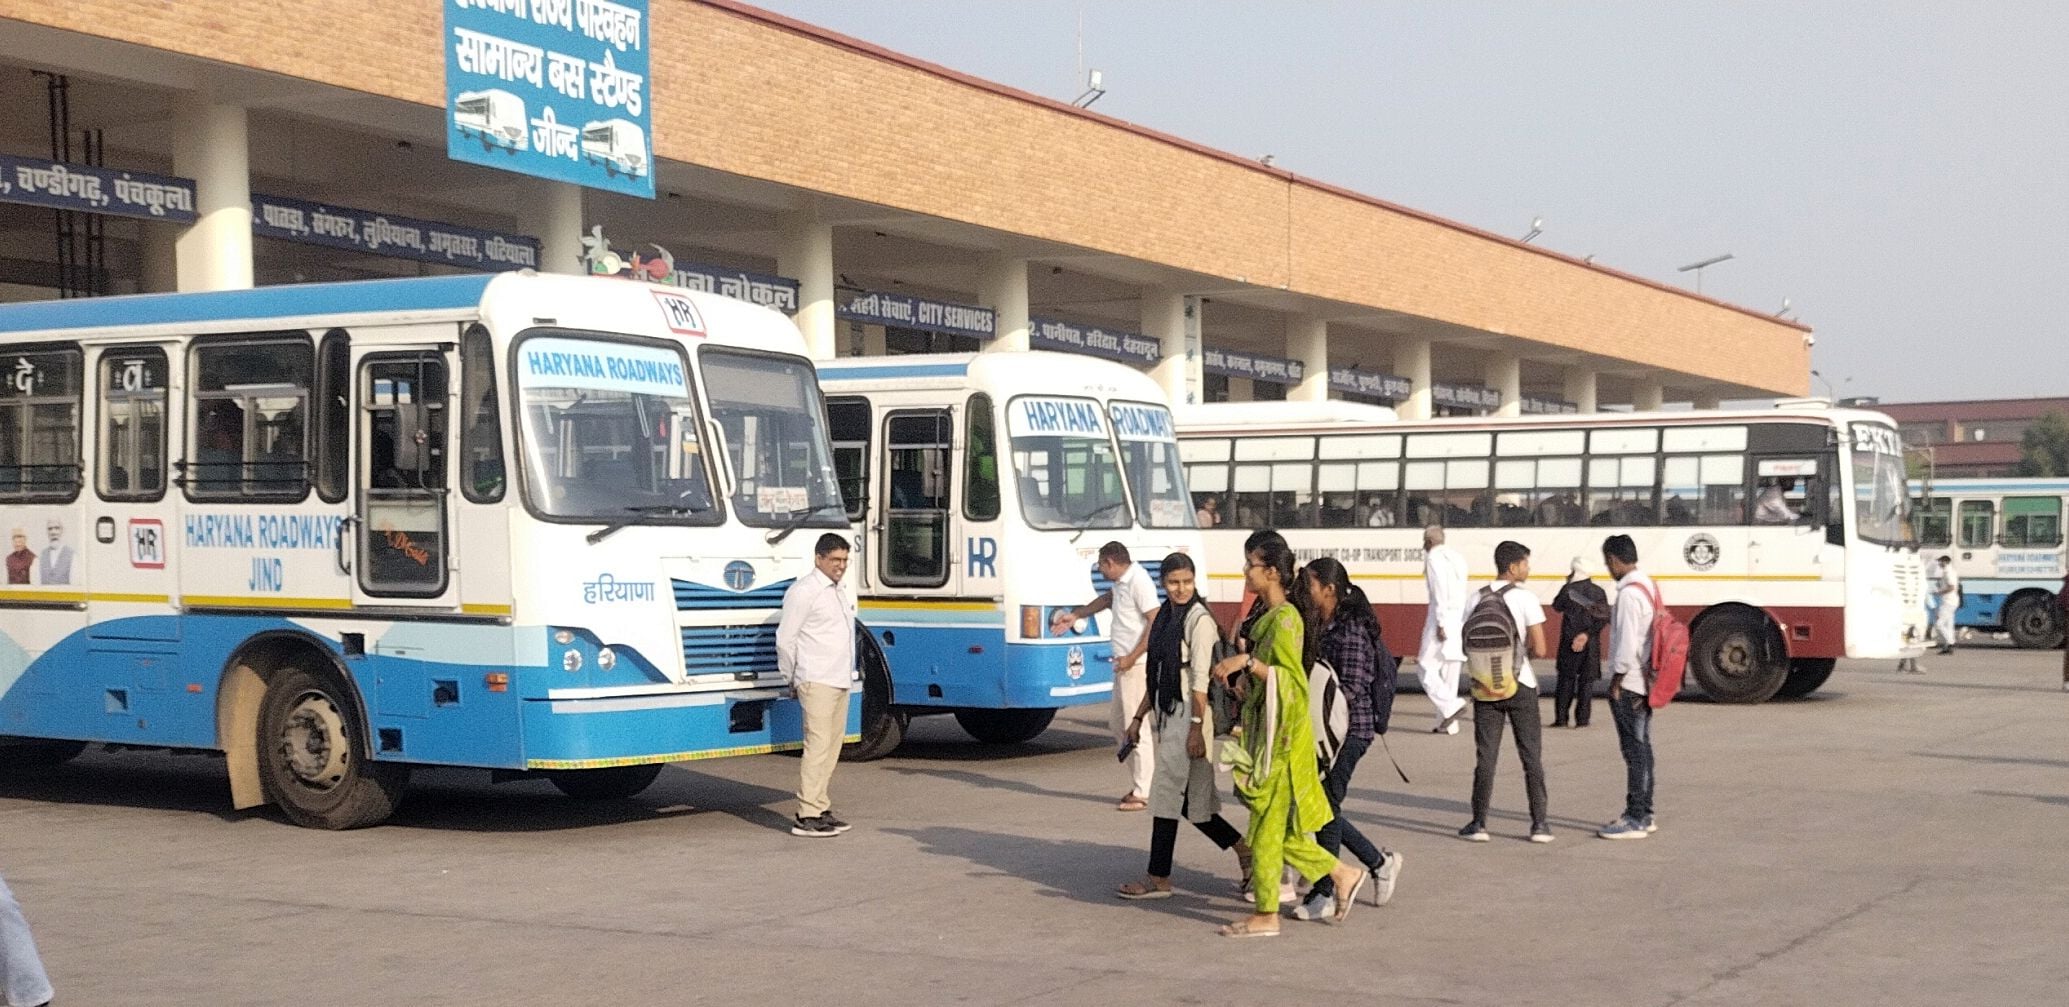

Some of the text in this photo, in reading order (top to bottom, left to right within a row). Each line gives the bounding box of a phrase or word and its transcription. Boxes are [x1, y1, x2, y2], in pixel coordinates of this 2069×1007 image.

[454, 26, 644, 117] सामान्य बस स्टैण्ड
[530, 105, 579, 161] जीन्द
[114, 173, 193, 216] पंचकूला
[484, 235, 536, 266] पटियाला
[719, 274, 797, 310] लोकल
[918, 301, 944, 327] CITY
[944, 306, 993, 333] SERVICES
[15, 357, 35, 396] दे
[528, 351, 683, 386] HARYANA ROADWAYS
[1023, 400, 1175, 438] HARYANA ROADWAY
[185, 514, 254, 548] HARYANA
[258, 514, 342, 550] ROADWAYS
[967, 536, 998, 578] HR
[1363, 548, 1401, 562] TRANSPORT
[1404, 548, 1423, 562] SOCIE
[249, 556, 284, 593] JIND
[583, 573, 655, 604] हरियाणा
